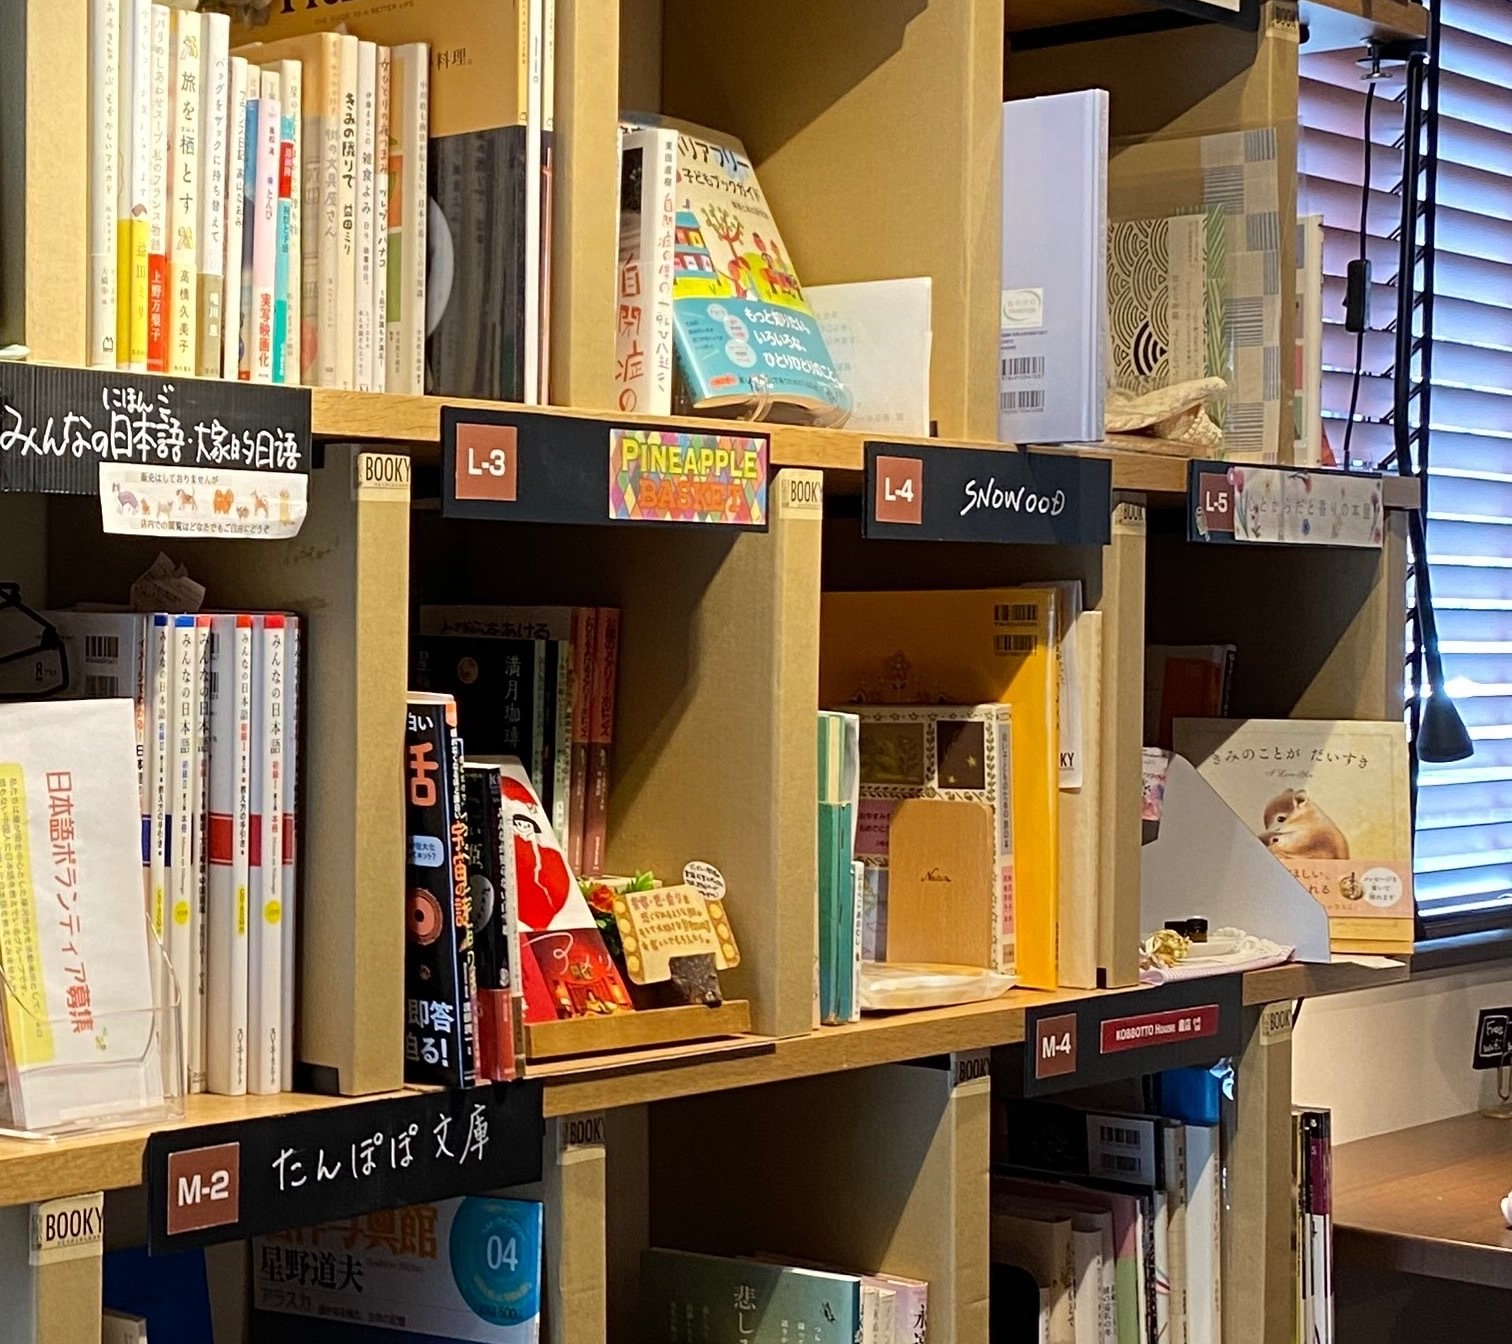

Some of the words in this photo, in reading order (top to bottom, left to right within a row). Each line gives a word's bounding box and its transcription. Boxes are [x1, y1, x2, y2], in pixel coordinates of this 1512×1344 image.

[258, 293, 270, 368] 実写映画化
[469, 448, 506, 476] L-3
[621, 438, 759, 479] PINEAPPLE
[640, 479, 741, 514] BASKET
[885, 478, 913, 503] L-4
[1206, 492, 1228, 512] L-5
[180, 633, 191, 755] みんなの日本語
[241, 633, 249, 721] みんなの日本語
[270, 633, 281, 754] みんなの日本語
[1211, 747, 1302, 766] きみのことが
[1310, 747, 1369, 769] だいすき
[409, 999, 454, 1034] 即答
[1042, 1032, 1072, 1058] M-4
[272, 1103, 489, 1190] たんぽぽ文庫
[177, 1170, 230, 1205] M-2
[261, 1245, 364, 1294] 星野道夫
[488, 1235, 518, 1272] 04
